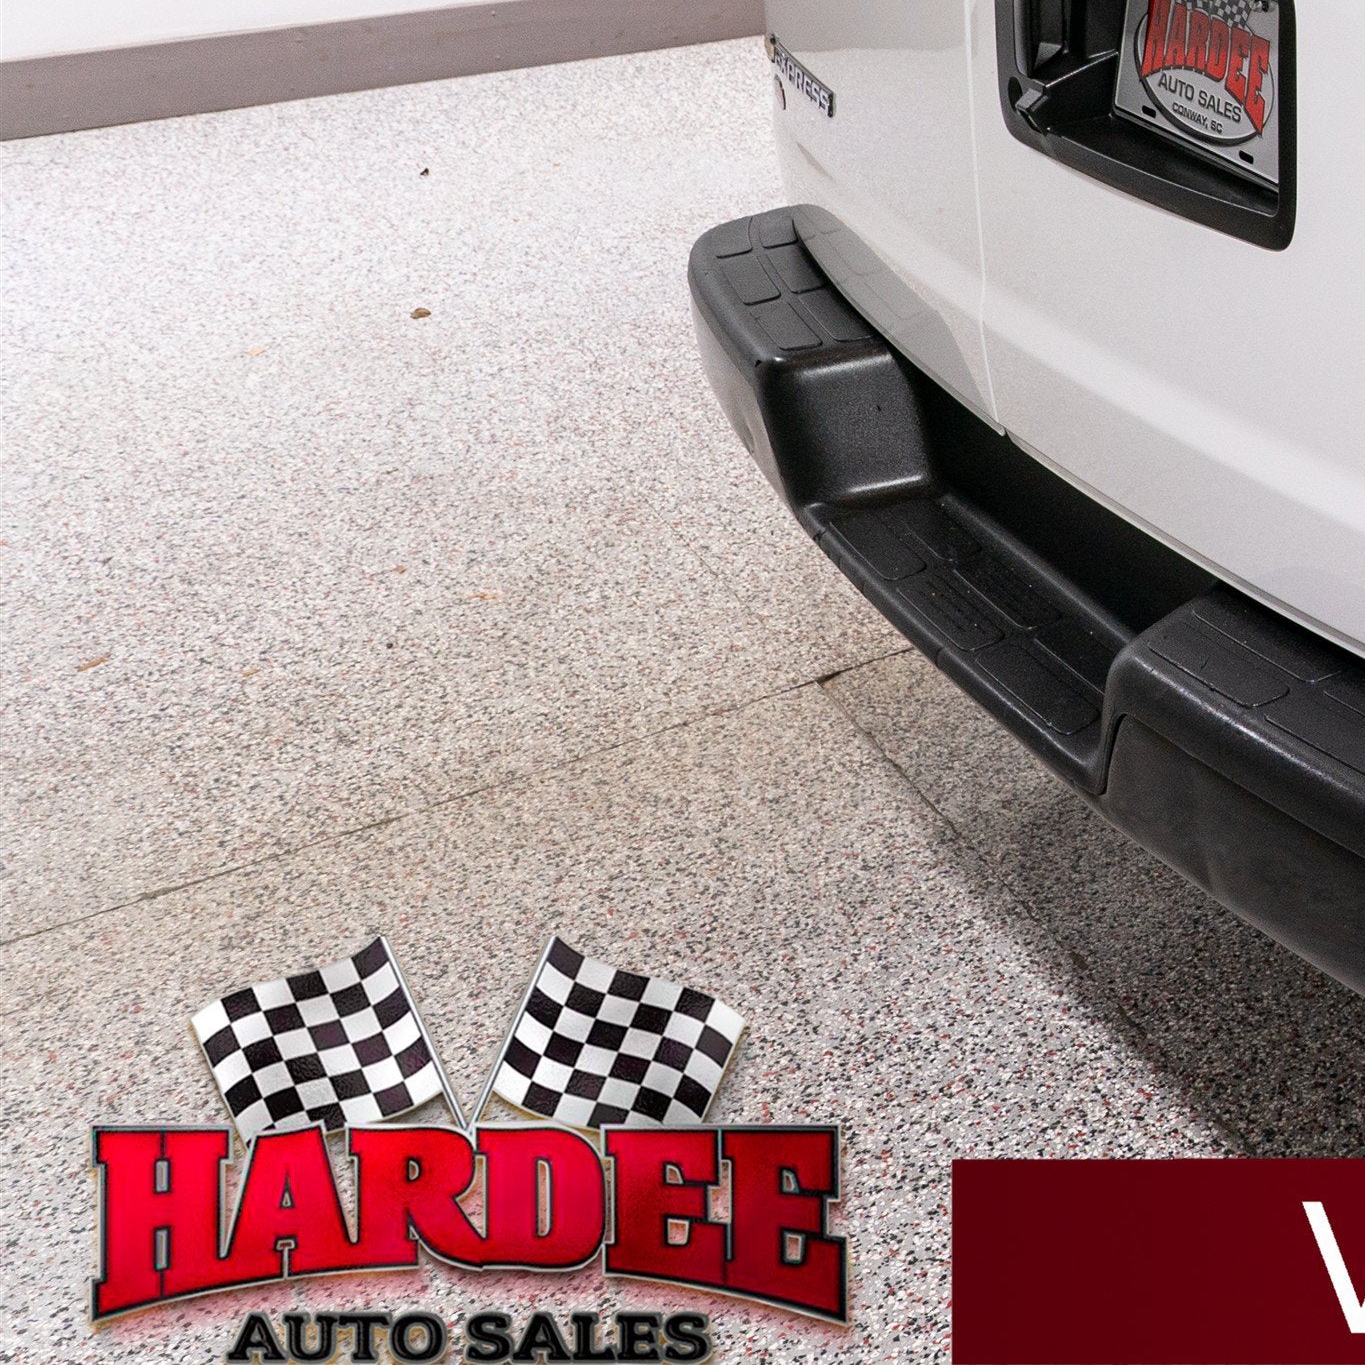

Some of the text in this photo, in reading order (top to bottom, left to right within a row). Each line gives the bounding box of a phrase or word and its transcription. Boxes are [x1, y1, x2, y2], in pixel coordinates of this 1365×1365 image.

[1158, 73, 1242, 123] AUTO SALES
[1172, 102, 1223, 134] CONWAY, SC
